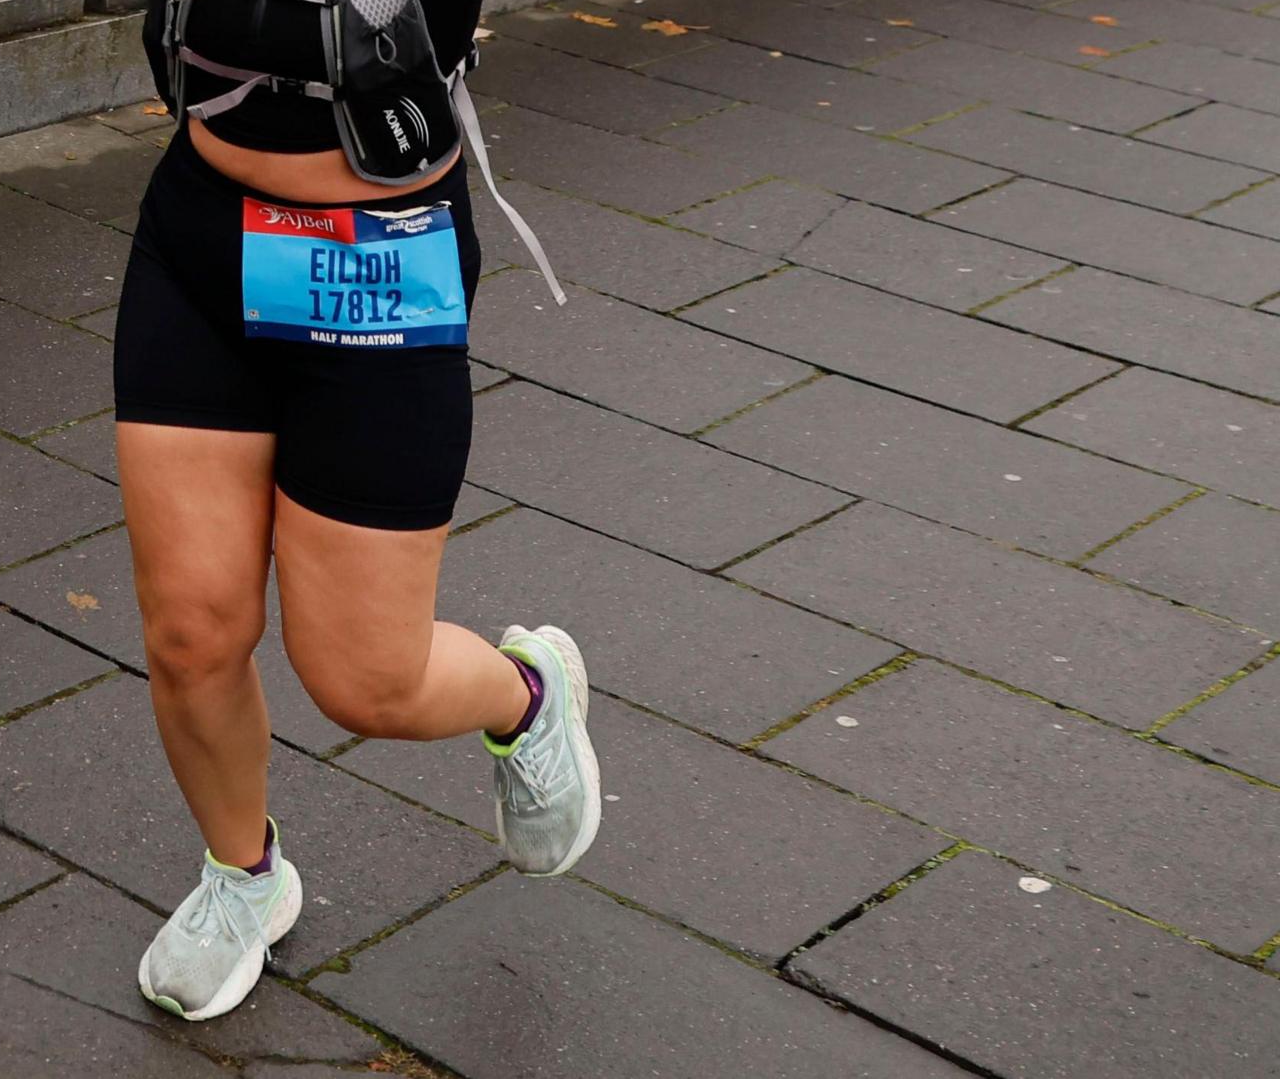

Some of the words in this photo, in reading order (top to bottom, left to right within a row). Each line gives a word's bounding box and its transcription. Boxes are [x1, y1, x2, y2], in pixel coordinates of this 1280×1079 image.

[383, 108, 411, 154] AONIJIE
[310, 248, 401, 284] EILIDH
[308, 289, 403, 324] 17812
[310, 330, 338, 344] HALF
[340, 333, 404, 345] MARATHON
